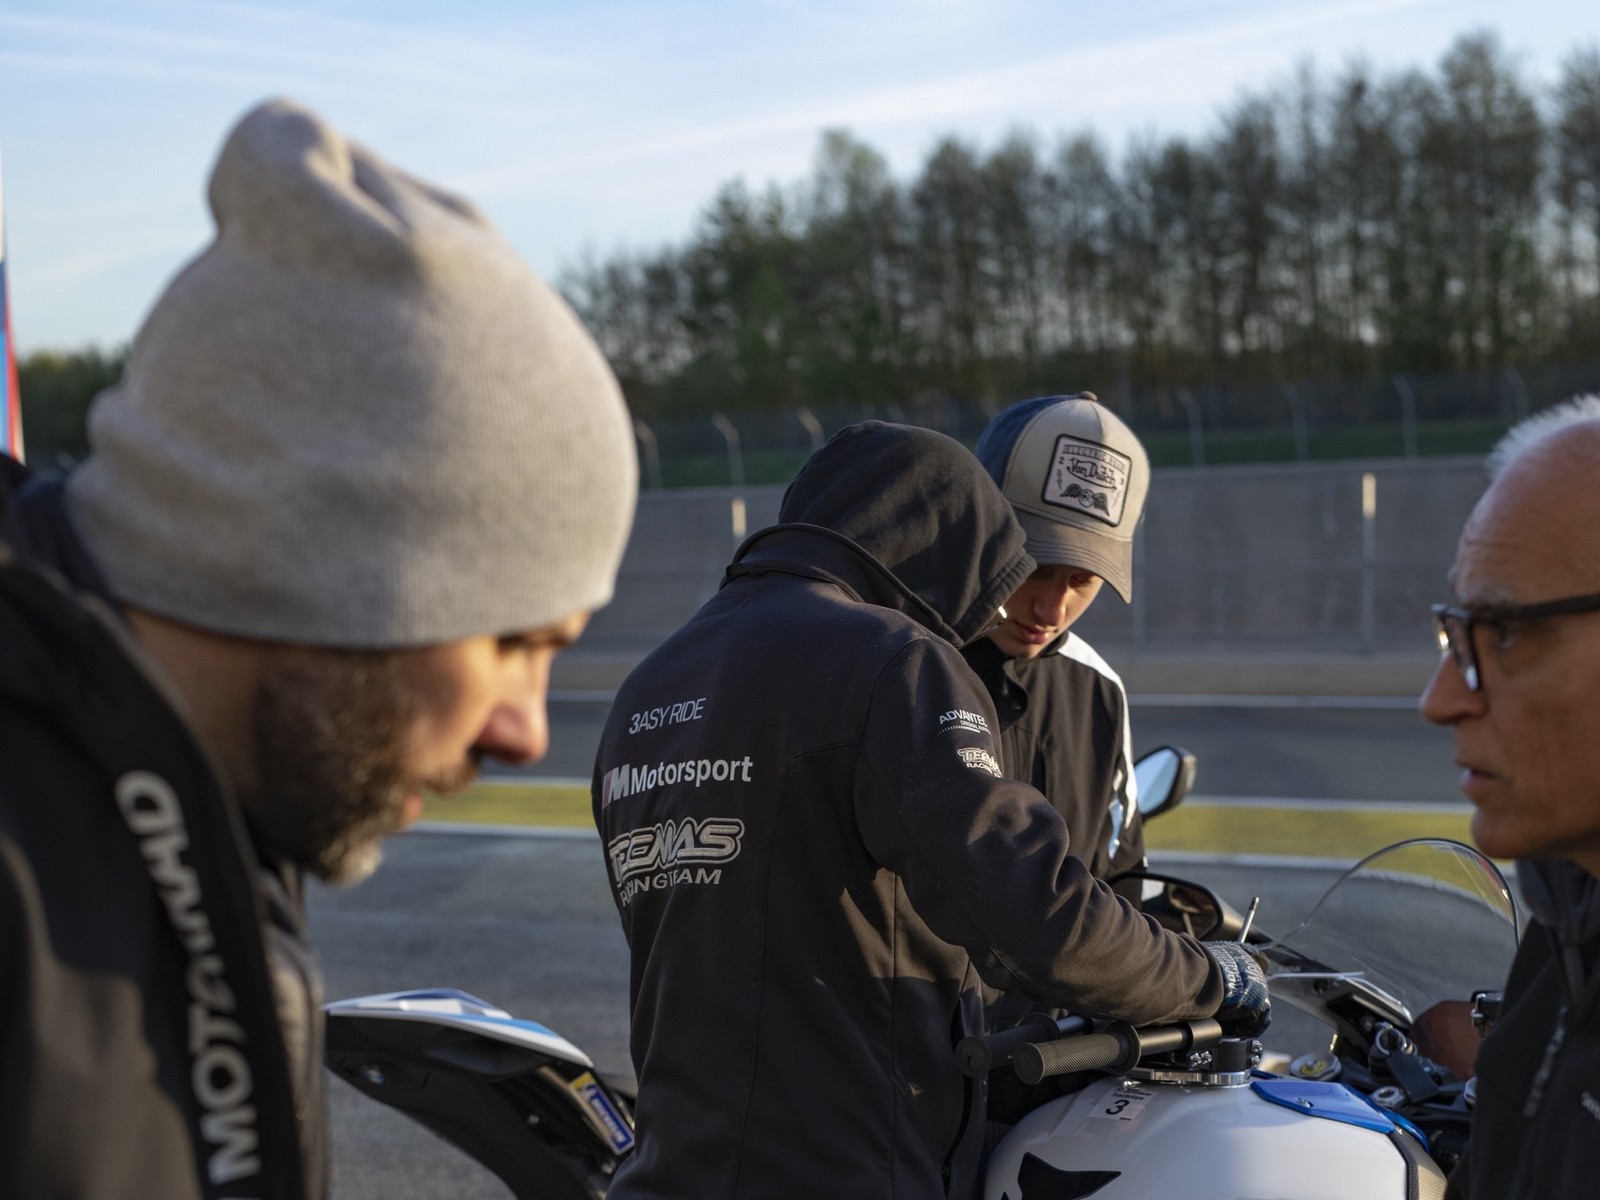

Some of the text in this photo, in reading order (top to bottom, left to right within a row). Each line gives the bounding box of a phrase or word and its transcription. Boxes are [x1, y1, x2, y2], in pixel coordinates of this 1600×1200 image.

[668, 698, 707, 725] RIDE
[630, 756, 754, 796] Motorsport
[1105, 1099, 1130, 1115] 3
